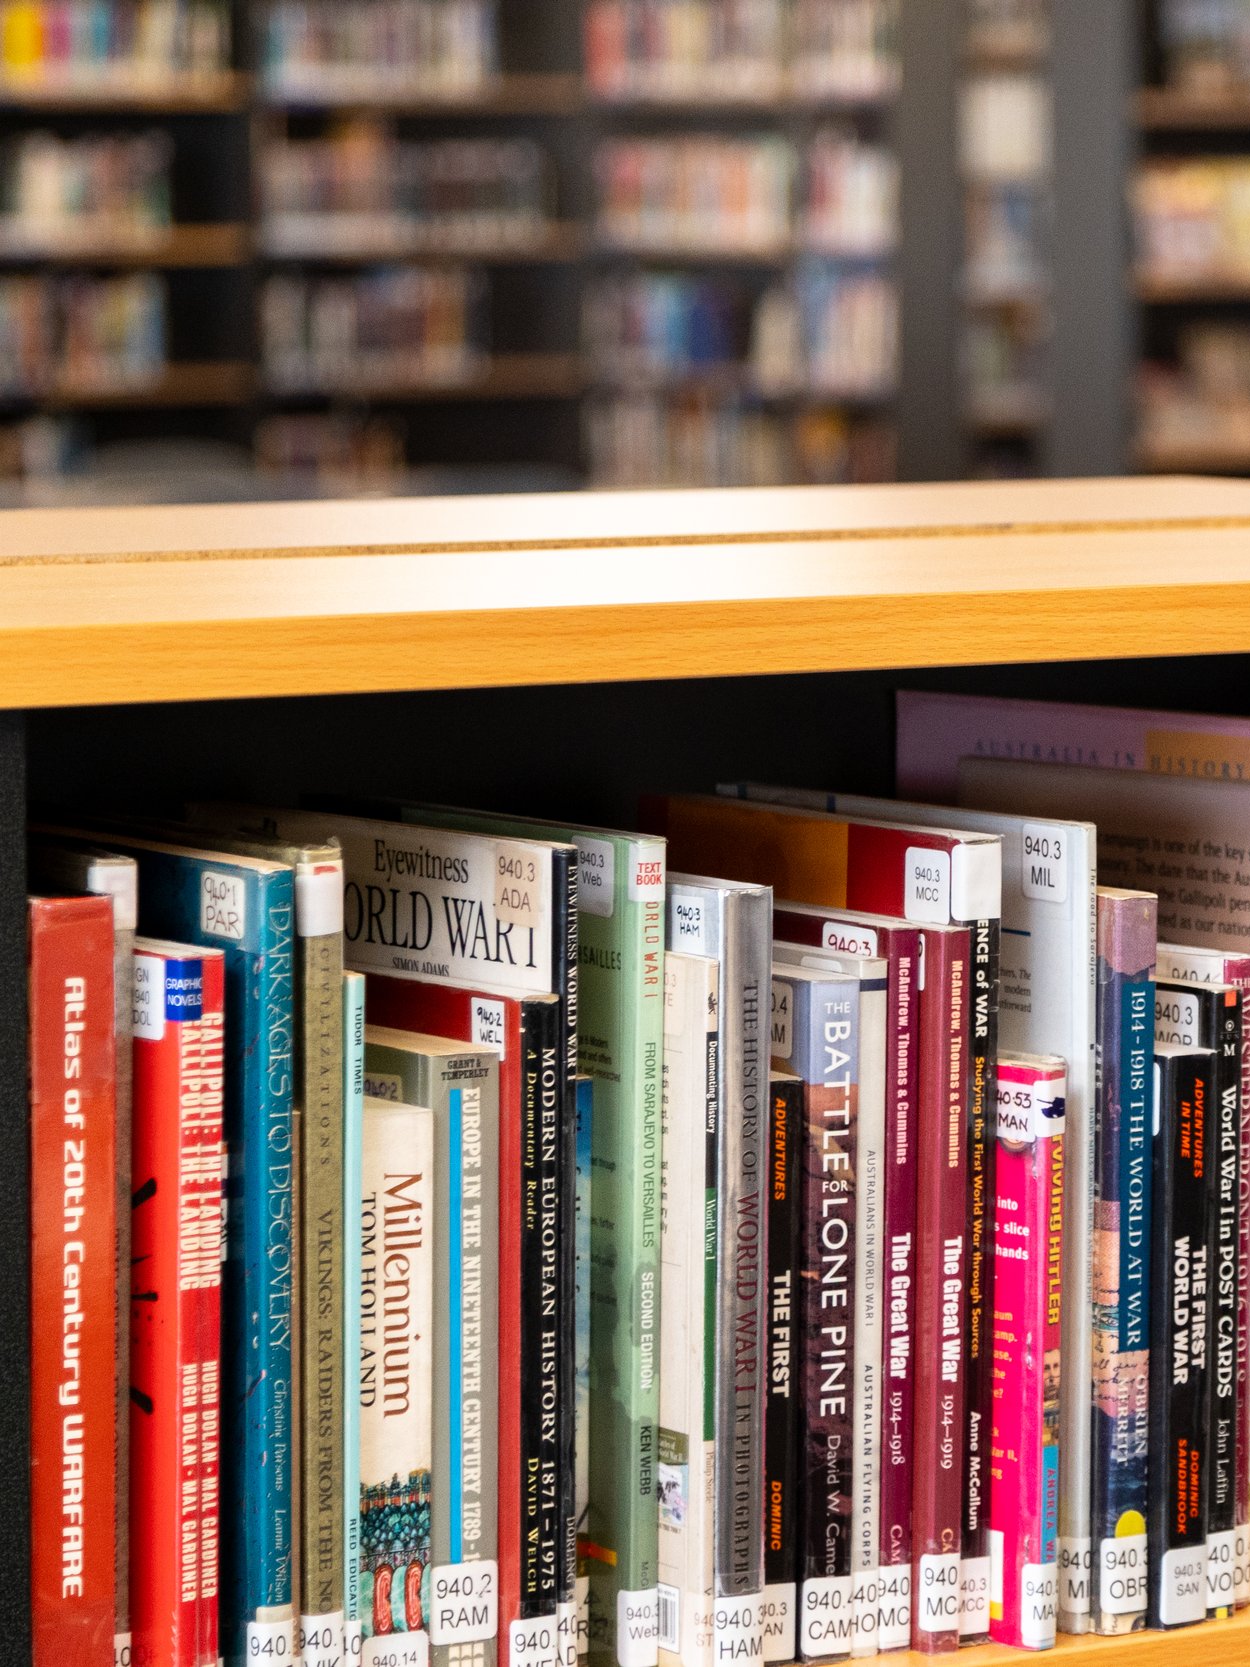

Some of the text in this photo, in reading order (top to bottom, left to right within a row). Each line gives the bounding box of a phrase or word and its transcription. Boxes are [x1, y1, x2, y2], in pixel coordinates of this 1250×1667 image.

[374, 839, 469, 884] Eyewitness
[498, 855, 536, 883] 940.3
[580, 850, 604, 868] 940.3
[581, 871, 602, 887] Web
[636, 874, 663, 886] BOOK
[637, 862, 662, 874] TEXT
[914, 866, 940, 883] 940.3
[1024, 835, 1062, 861] 940.3
[1030, 866, 1056, 889] MIL
[205, 905, 240, 938] PAR
[499, 887, 532, 913] ADA
[916, 886, 940, 902] MCC
[1179, 890, 1225, 911] Gallipoli
[679, 923, 700, 937] HAM
[136, 969, 149, 983] GN
[167, 993, 203, 1007] NOVELS
[392, 956, 450, 978] SIMON ADAMS
[480, 1027, 502, 1044] WEL
[825, 1000, 850, 1014] THE
[319, 947, 332, 1167] CIVILIZATIONS
[354, 1005, 363, 1095] TUDOR TIMES
[441, 1068, 489, 1081] TEMPERLEY
[705, 1041, 717, 1134] Documenting History
[822, 1021, 851, 1172] BATTLE
[268, 904, 293, 1352] DARK AGES TO DISCOVERY
[524, 1050, 537, 1230] A Documentary Reader
[642, 1042, 657, 1248] FROM SARAJEVO TO VERSAILLES
[774, 1098, 787, 1201] ADVENTURES
[1181, 1101, 1191, 1160] IN TIME
[1193, 1078, 1205, 1180] ADVENTURES
[822, 1180, 848, 1193] FOR
[970, 1056, 985, 1359] Studying the First World War through Sources
[995, 1245, 1029, 1260] hands
[1217, 1085, 1237, 1398] World War I in POST CARDS
[58, 976, 86, 1601] Atlas of 20th Century WARFARE
[360, 1191, 377, 1408] TOM HOLLAND
[383, 1172, 423, 1418] Millennium
[541, 1048, 556, 1590] MODERN EUROPEAN HISTORY 1871 1975
[735, 980, 760, 1588] THE HISTORY OF WORLD WAR I IN PHOTOGRAPHS
[820, 1198, 849, 1417] LONE PINE
[890, 1232, 911, 1380] The Great War
[941, 1235, 963, 1383] The Great War
[1173, 1236, 1190, 1386] WORLD WAR
[1190, 1244, 1207, 1370] THE FIRST
[640, 1272, 655, 1395] SECOND EDITION
[771, 1270, 791, 1398] THE FIRST
[200, 1360, 217, 1599] HUGH DOLAN MAL GARDINER
[639, 1425, 652, 1496] KEN WEBB
[862, 1365, 873, 1567] AUSTRALIAN FLYING CORPS
[968, 1411, 981, 1531] Anne McCallum
[1177, 1439, 1188, 1535] SANDBROOK
[1190, 1450, 1200, 1519] DOMINIC
[527, 1458, 539, 1593] DAVID WELCH
[771, 1480, 783, 1552] DOMINIC
[436, 1573, 492, 1600] 940.2
[440, 1606, 488, 1630] RAM
[1176, 1582, 1200, 1597] SAN
[719, 1636, 763, 1660] HAM
[808, 1618, 851, 1640] CAM
